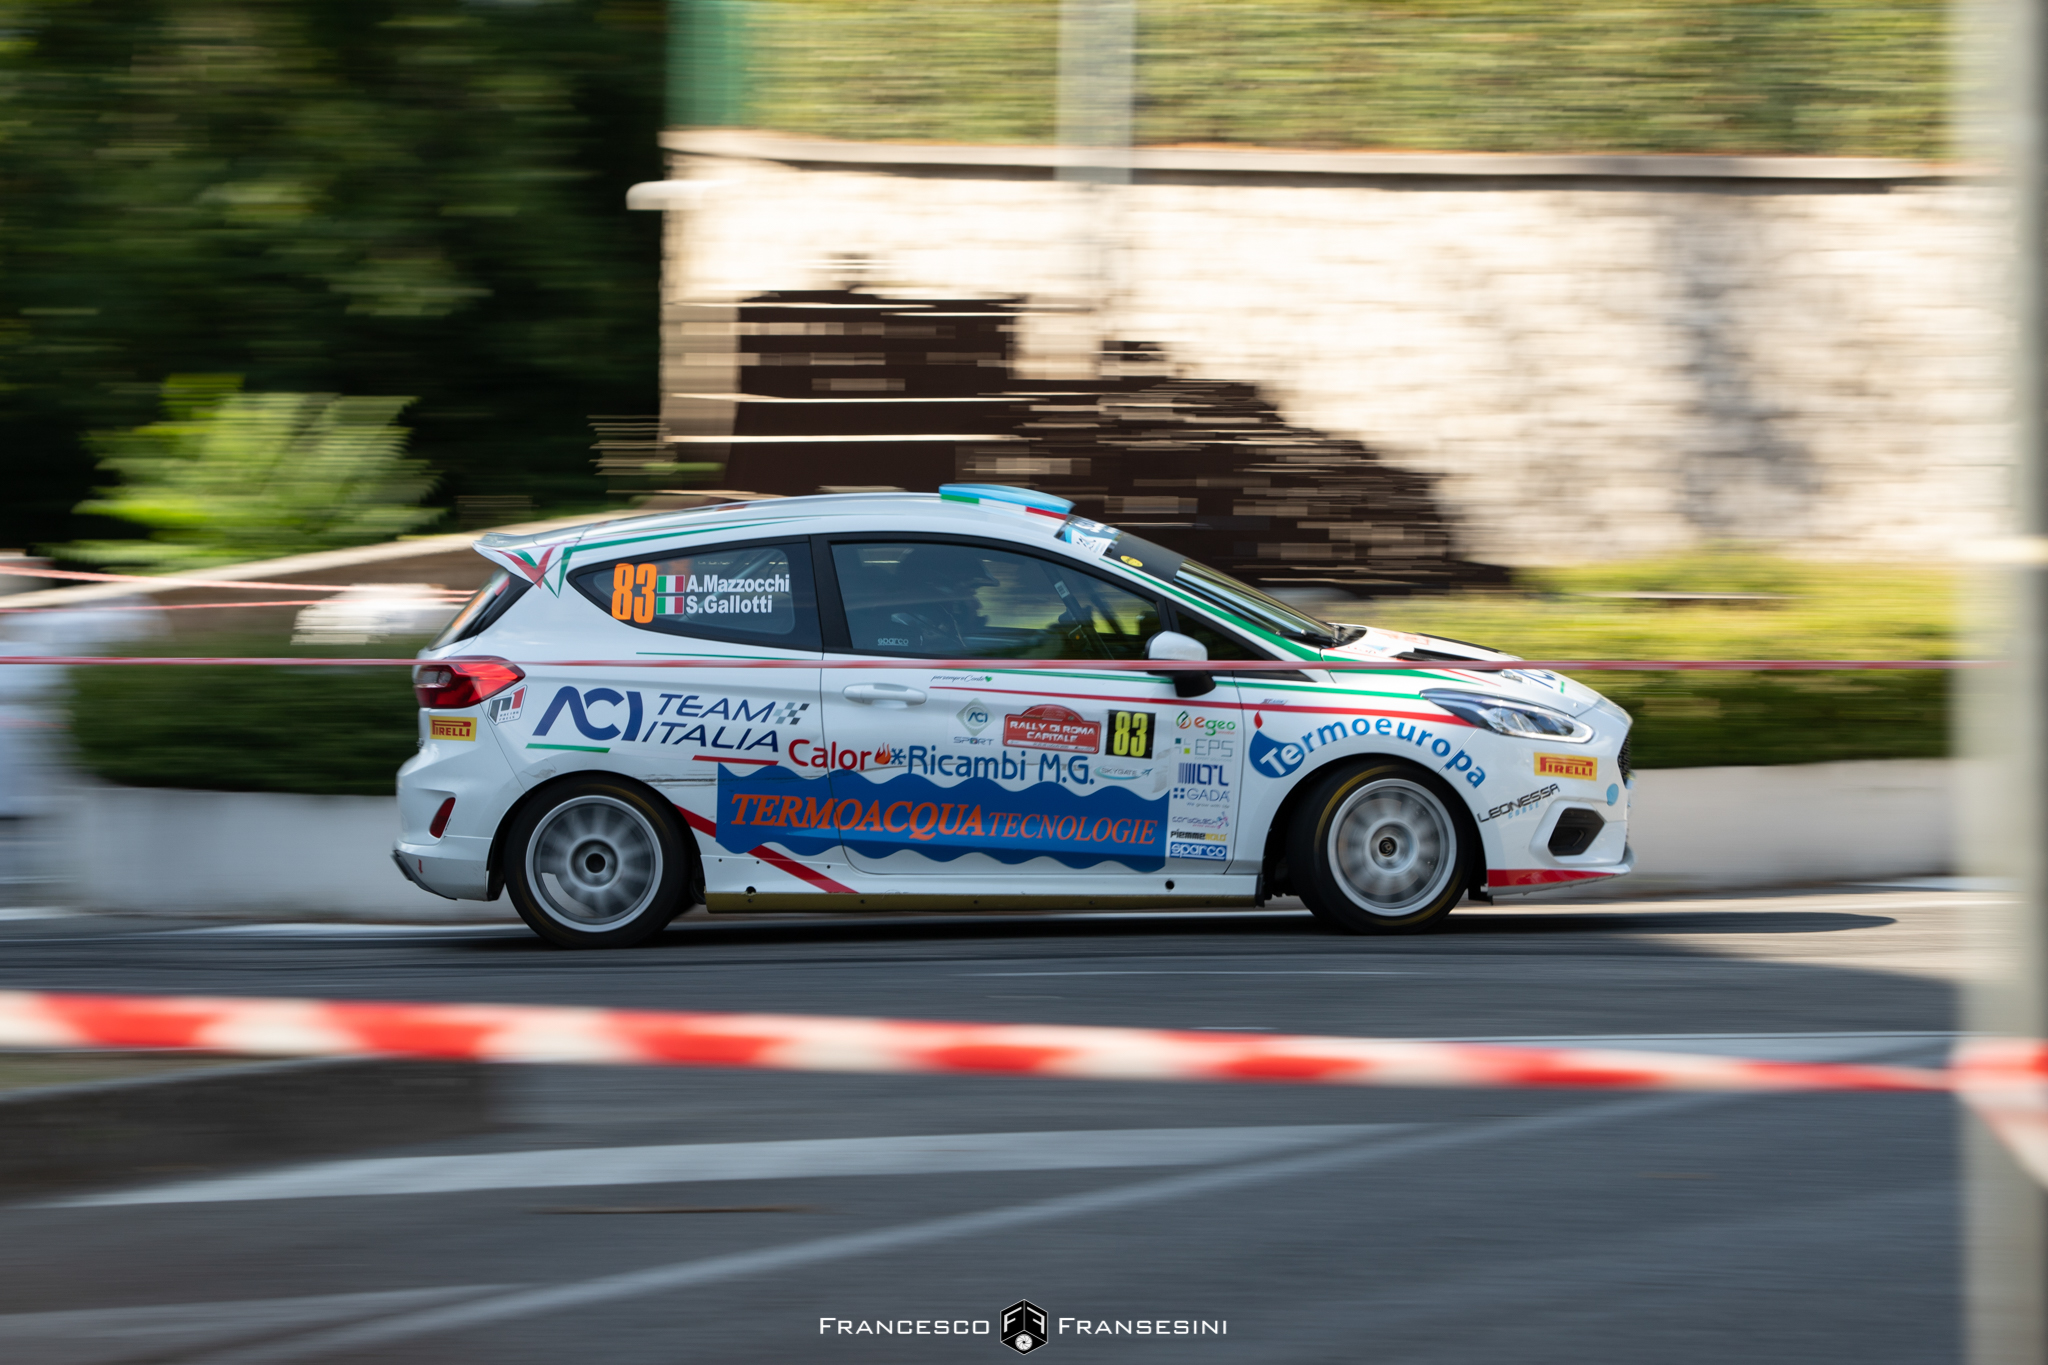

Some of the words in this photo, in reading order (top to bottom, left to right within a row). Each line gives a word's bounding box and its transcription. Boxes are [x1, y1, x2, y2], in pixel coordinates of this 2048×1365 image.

[612, 563, 657, 623] 83
[686, 574, 790, 593] A.Mazzocchi
[686, 595, 773, 614] S.Gallotti
[532, 685, 644, 742] ACI
[657, 693, 776, 723] TEAM
[967, 711, 989, 723] ACI
[432, 720, 471, 737] PIRELLI
[1010, 720, 1047, 731] RALLY
[1049, 724, 1061, 732] DI
[1063, 725, 1096, 735] ROMA
[1113, 711, 1148, 757] 83
[1194, 716, 1236, 736] egeo
[642, 721, 779, 753] ITALIA
[953, 736, 995, 746] SPORT
[1026, 731, 1078, 742] CAPITALE
[1195, 738, 1233, 757] EPS
[1260, 717, 1487, 789] Termoeuropa
[788, 739, 872, 770] Calor
[908, 745, 1027, 781] Ricambi
[1038, 753, 1095, 786] M.G.
[1539, 756, 1594, 777] PIRELLI
[1476, 783, 1561, 823] LEONESSA
[1508, 802, 1540, 819] CORSE
[730, 793, 985, 841] TERMOACQUA
[985, 811, 1158, 845] TECNOLOGIE
[1170, 843, 1225, 858] sparco
